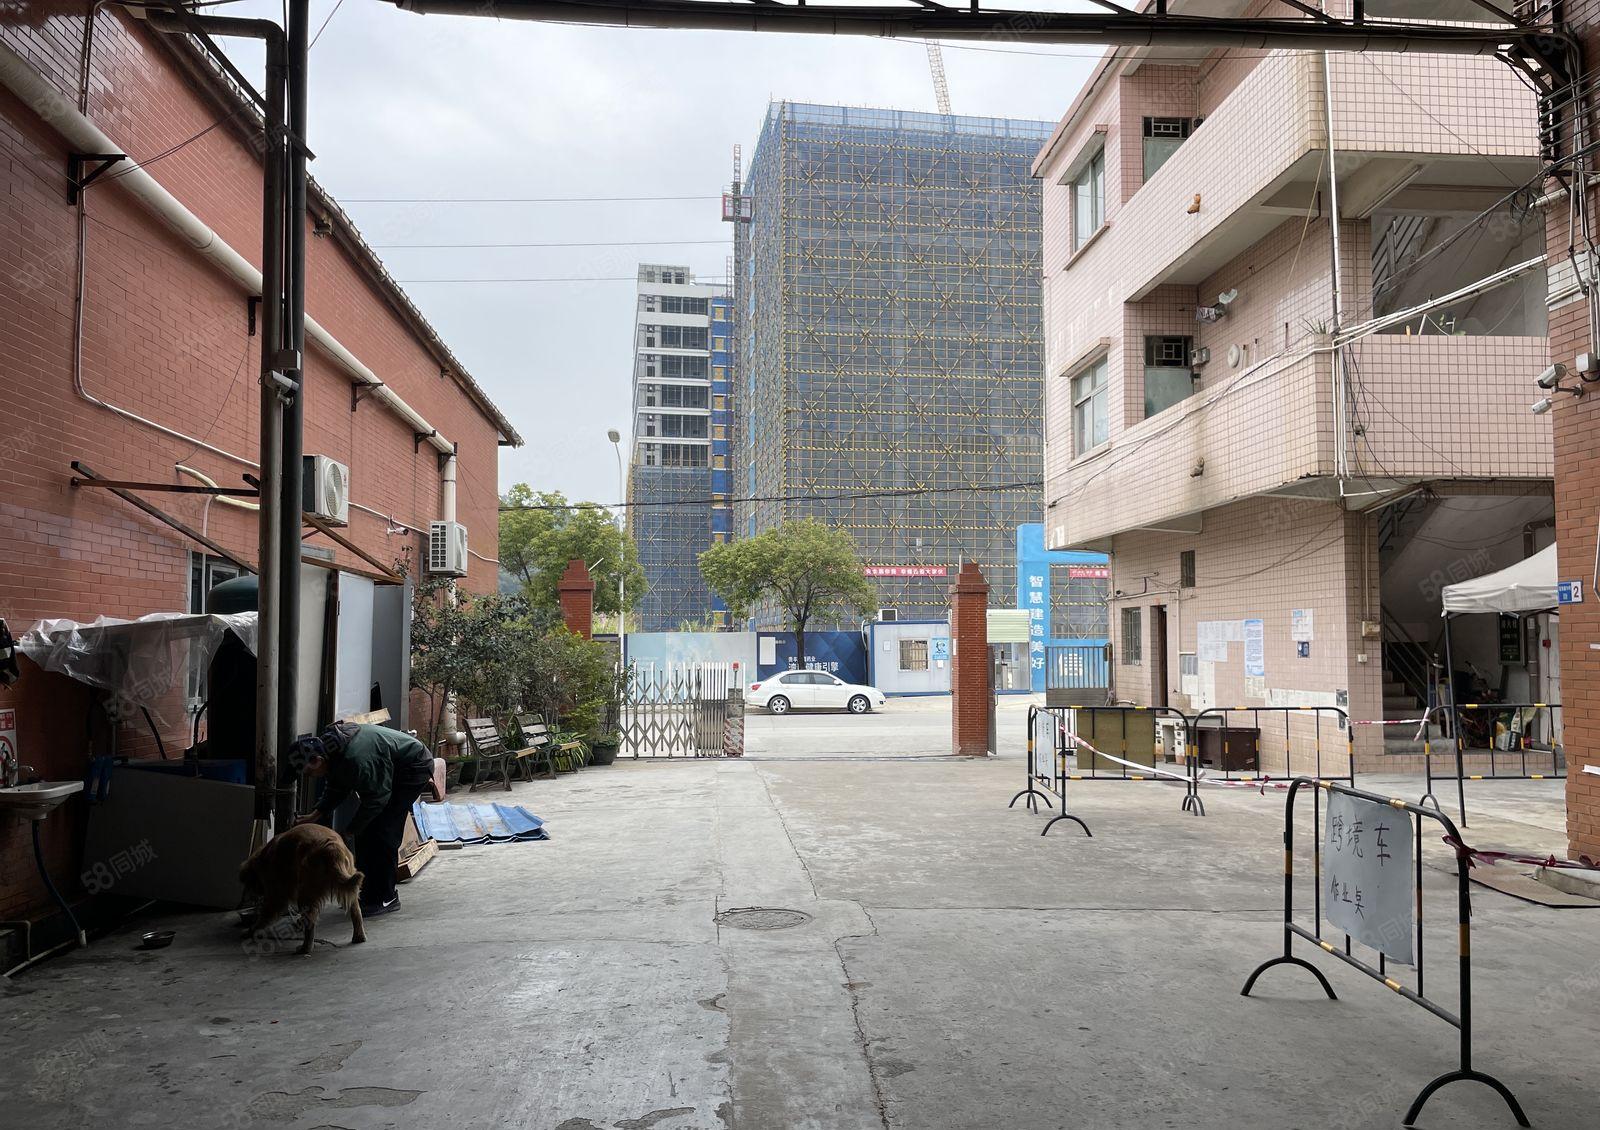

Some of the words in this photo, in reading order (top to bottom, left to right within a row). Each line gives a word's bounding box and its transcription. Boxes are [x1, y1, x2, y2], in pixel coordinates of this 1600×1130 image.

[1573, 586, 1579, 598] 2
[1029, 575, 1045, 669] 智慧建造美好
[1331, 815, 1391, 866] 跨境车
